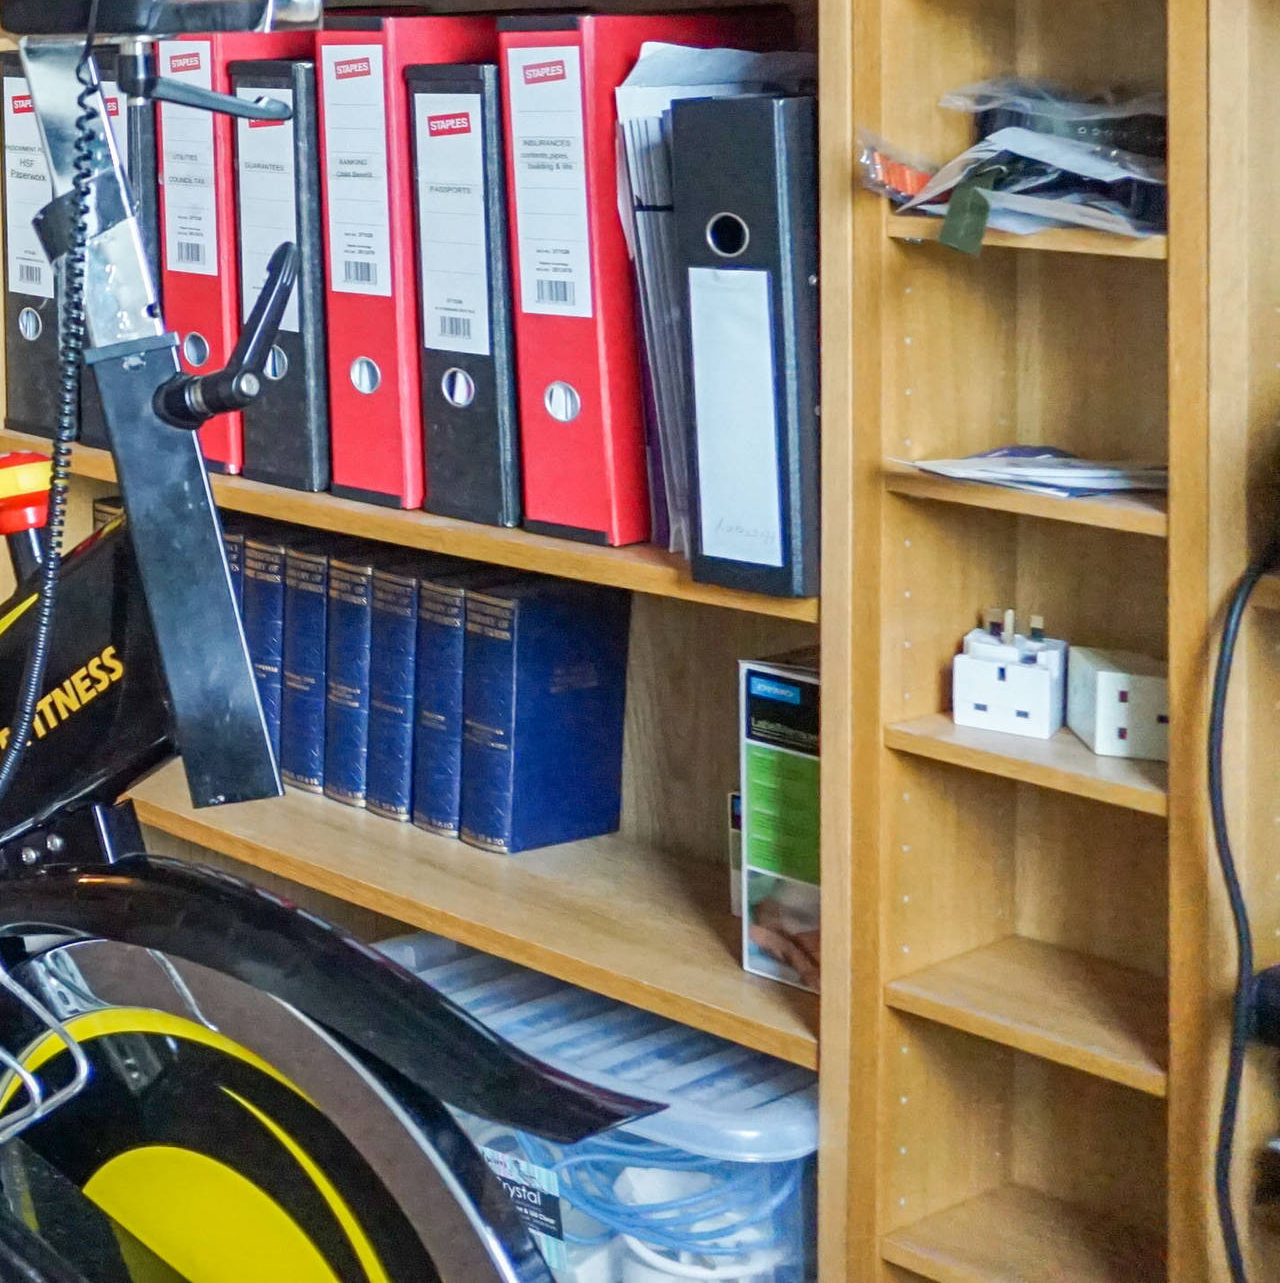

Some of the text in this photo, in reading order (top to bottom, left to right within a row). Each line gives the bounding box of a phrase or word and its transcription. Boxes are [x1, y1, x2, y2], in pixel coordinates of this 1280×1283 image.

[172, 57, 199, 69] STAPLES
[336, 62, 369, 75] STAPLES
[525, 65, 564, 80] STAPLES
[430, 116, 469, 131] STAPLES
[244, 161, 285, 172] GUARANTEES
[10, 169, 47, 182] Paperwork
[168, 176, 193, 184] COUNCIL
[429, 185, 472, 195] PASSPORTS
[28, 645, 124, 740] ITNESS
[502, 1181, 542, 1206] rystal
